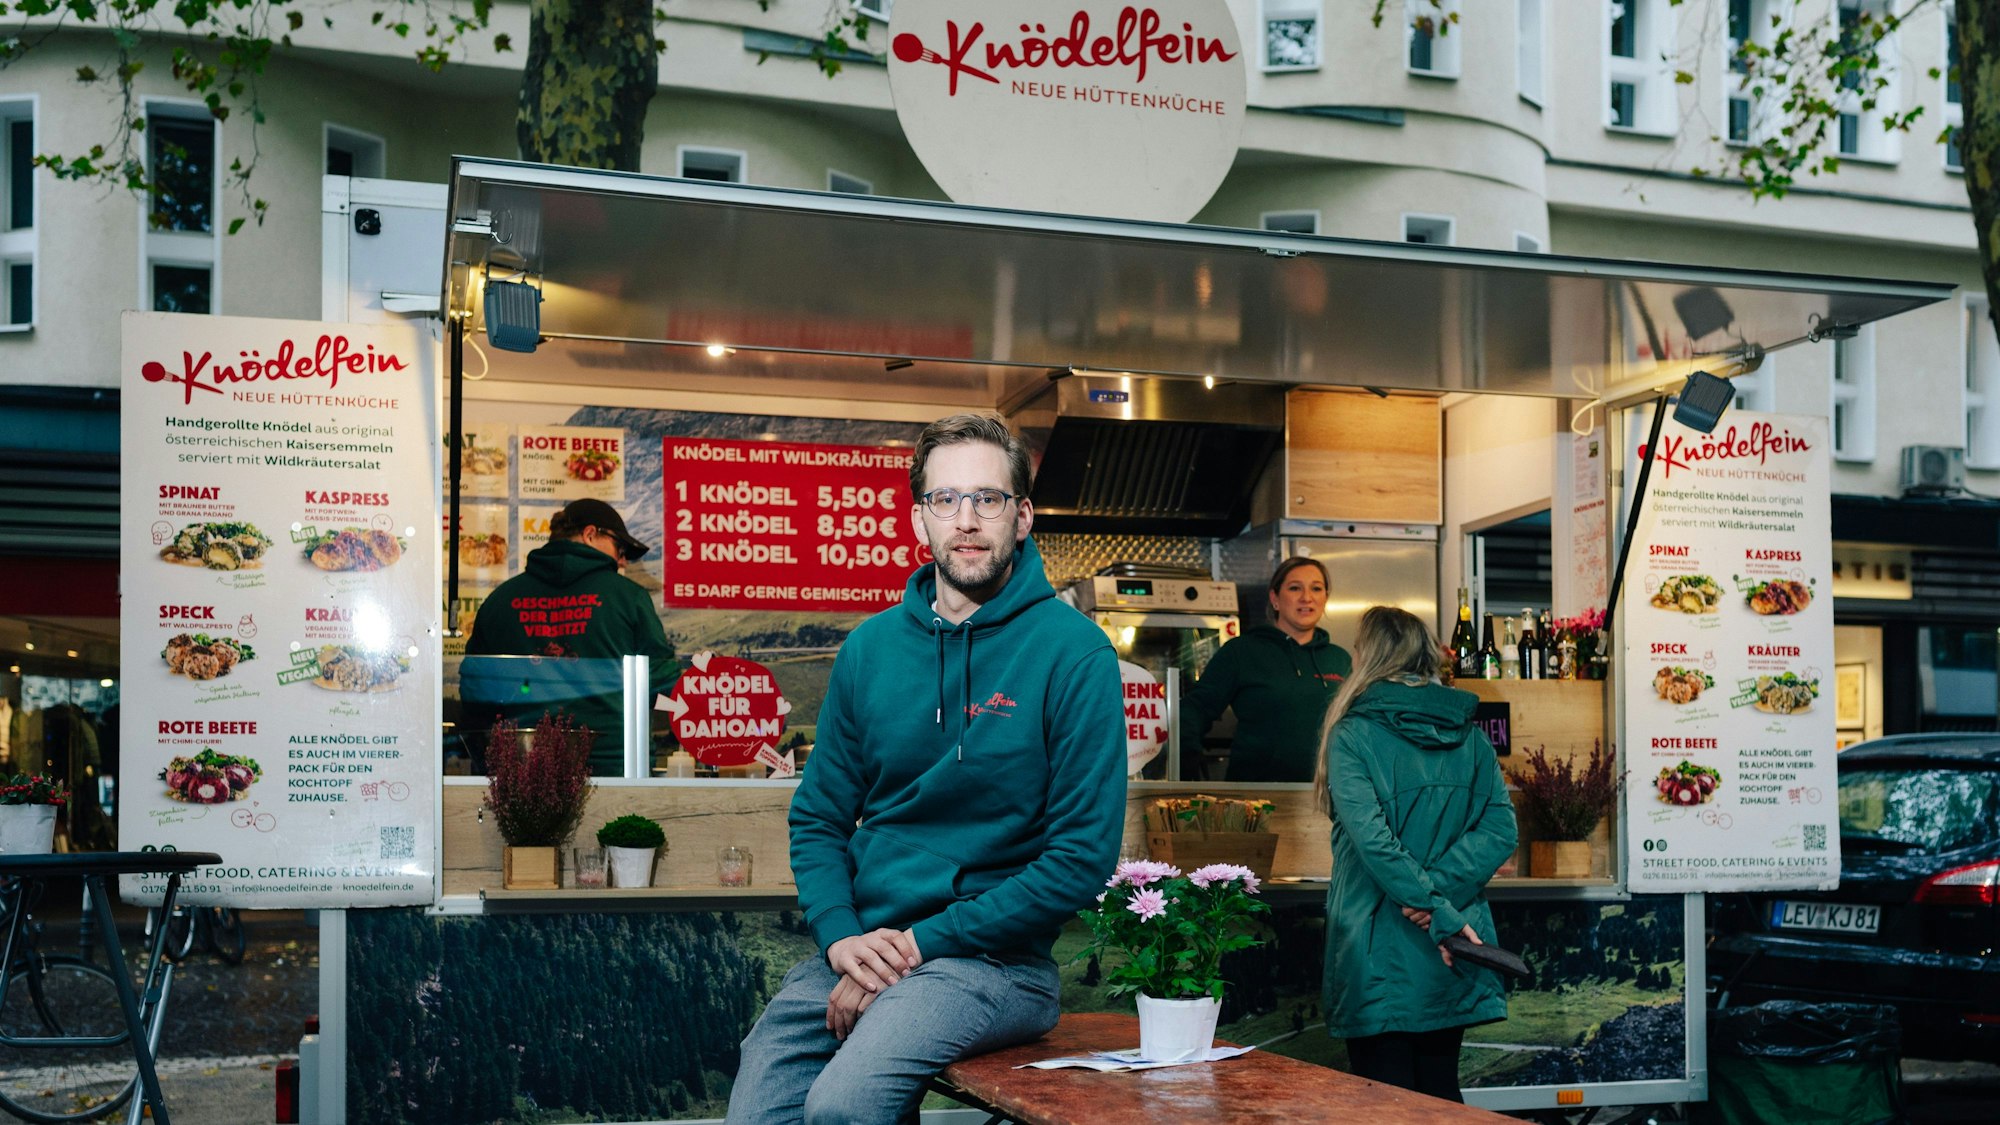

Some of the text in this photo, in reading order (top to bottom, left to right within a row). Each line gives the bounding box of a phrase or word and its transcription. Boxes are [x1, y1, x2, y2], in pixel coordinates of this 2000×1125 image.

[946, 6, 1238, 96] Knödelfein
[1011, 80, 1226, 116] NEUE HÜTTENKÜCHE
[182, 334, 410, 406] Knödelfein
[233, 391, 400, 410] NEUE HÜTTENKÜCHE
[165, 416, 394, 439] Handgerollte Knödel aus original
[165, 433, 394, 454] österreichischen Kaisersemmeln
[523, 436, 619, 453] ROTE BEETE
[1664, 422, 1812, 479] Knödelfein
[178, 452, 382, 471] serviert mit Wildkräutersalat
[522, 453, 555, 461] KNÖDEL
[673, 443, 914, 470] KNÖDEL MIT WILDKRÄUTERS
[1696, 467, 1807, 483] NEUE HÜTTENKÜCHE
[159, 485, 221, 501] SPINAT
[305, 489, 390, 507] KASPRESS
[523, 486, 555, 494] CHURRI
[675, 480, 897, 512] 1 KNÖDEL 5,50€
[1652, 488, 1804, 506] Handgerollte Knödel aus original
[173, 502, 207, 510] BRAUNER
[1652, 502, 1804, 519] österreichischen Kaisersemmeln
[175, 510, 202, 518] GRANA
[203, 511, 234, 519] PADANO
[676, 509, 898, 541] 2 KNÖDEL 8,50€
[1661, 518, 1796, 533] serviert mit Wildkräutersalat
[293, 528, 315, 542] NEU
[676, 538, 910, 570] 3 KNÖDEL 10,50€
[1649, 544, 1690, 557] SPINAT
[1745, 549, 1802, 562] KASPRESS
[674, 584, 695, 598] ES
[698, 584, 741, 599] DARF
[743, 585, 798, 600] GERNE
[801, 587, 882, 602] GEMISCHT
[511, 593, 603, 610] GESCHMACK,
[159, 605, 215, 620] SPECK
[305, 606, 354, 622] KRÄU
[519, 607, 593, 623] DER BERGE
[173, 622, 233, 630] WALDPILZPESTO
[524, 621, 588, 637] VERSETZT
[291, 650, 315, 664] NEU
[1650, 643, 1687, 655] SPECK
[1748, 643, 1801, 656] KRÄUTER
[278, 666, 319, 684] VEGAN
[683, 672, 775, 695] KNÖDEL
[708, 694, 751, 717] FÜR
[158, 721, 257, 735] ROTE BEETE
[680, 718, 780, 739] DAHOAM
[288, 733, 398, 745] ALLE KNÖDEL GIBT
[1651, 737, 1718, 749] ROTE BEETE
[288, 750, 404, 759] ES AUCH IM VIERER-
[697, 739, 763, 760] yummy
[1739, 748, 1813, 757] ALLE KNÖDEL GIBT
[288, 762, 373, 773] PACK FÜR DEN
[288, 779, 353, 788] KOCHTOPF
[1739, 771, 1796, 781] PACK FÜR DEN
[1739, 785, 1783, 793] KOCHTOPF
[288, 793, 348, 803] ZUHAUSE.
[1740, 797, 1780, 805] ZUHAUSE.
[1643, 857, 1828, 868] STREET FOOD, CATERING & EVENTS
[141, 866, 404, 880] STRET FOOD, CATERING & EVEN
[141, 885, 166, 894] 0176
[194, 885, 207, 893] 50
[209, 885, 221, 893] 91
[231, 883, 333, 893] info@knoedelfein.de
[342, 882, 414, 892] knoedelfein.de
[1782, 901, 1877, 931] LEV KJ 81
